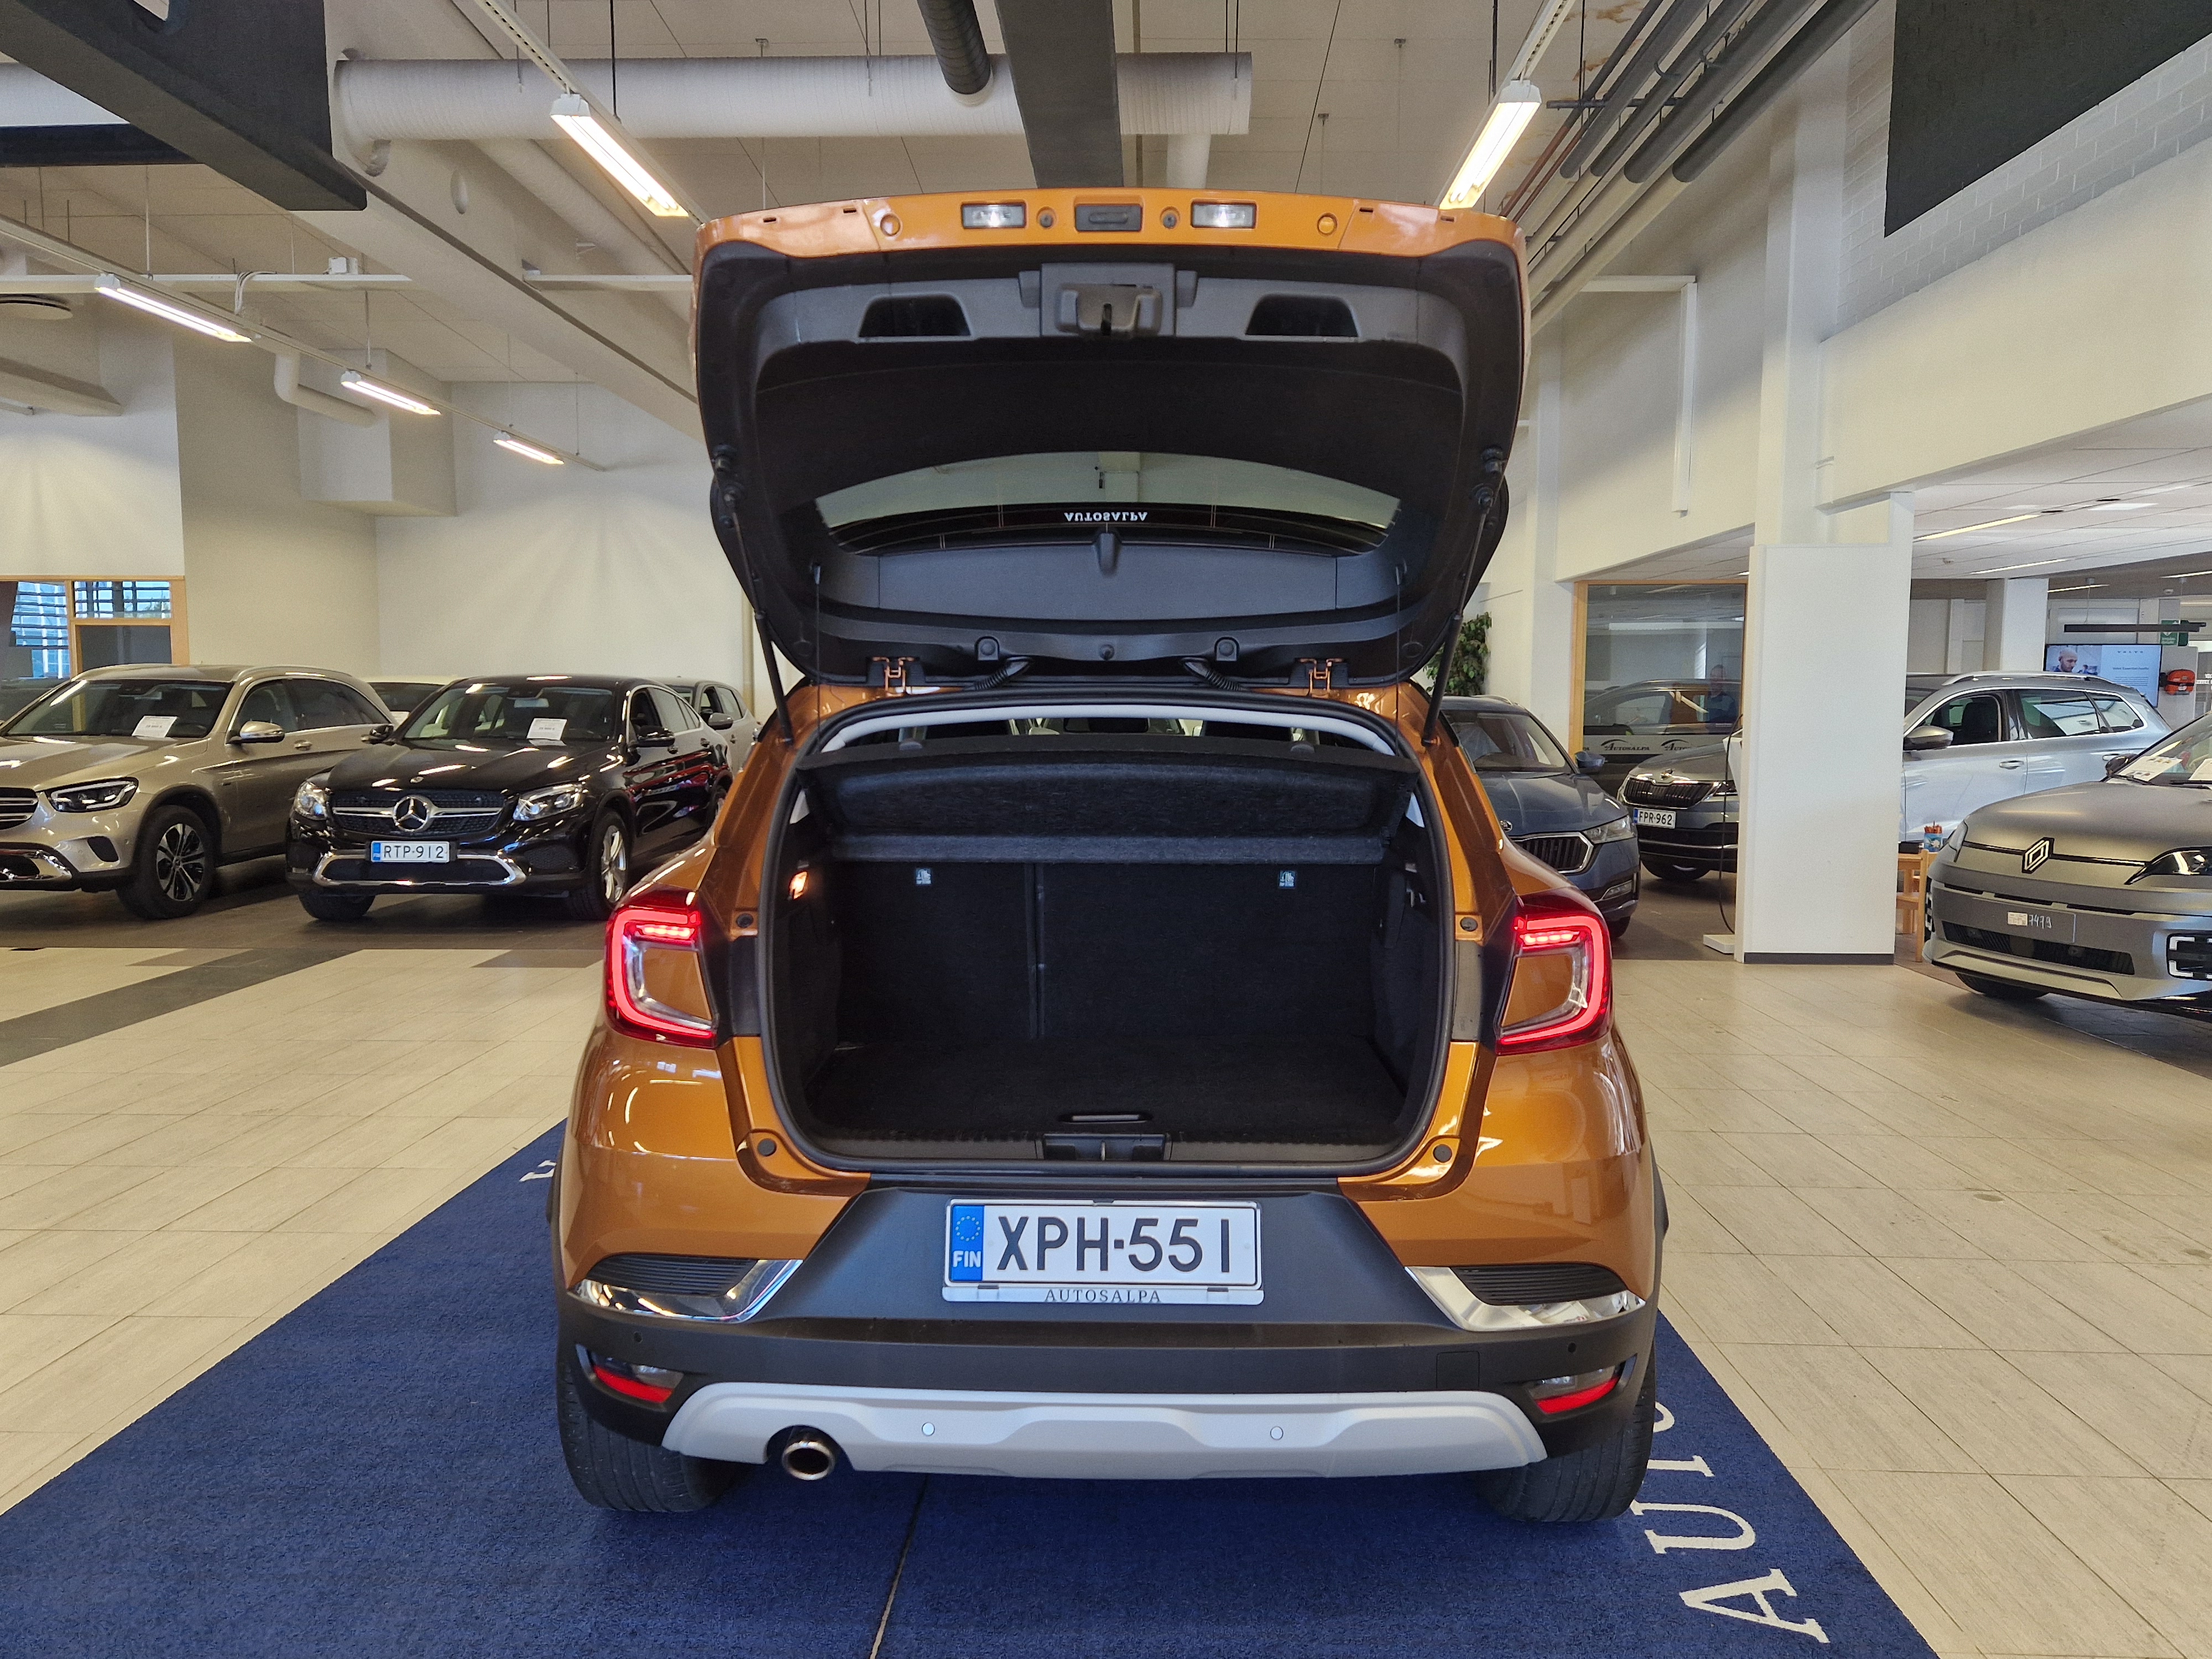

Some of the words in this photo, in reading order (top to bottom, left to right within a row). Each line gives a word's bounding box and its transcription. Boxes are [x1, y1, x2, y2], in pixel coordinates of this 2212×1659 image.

[1639, 811, 1672, 826] FPR-962
[384, 846, 444, 858] RTP-912
[2029, 914, 2052, 929] 7479
[952, 1250, 982, 1268] FIN
[997, 1216, 1230, 1274] XPH-551
[1045, 1288, 1161, 1303] AUTOSALPA
